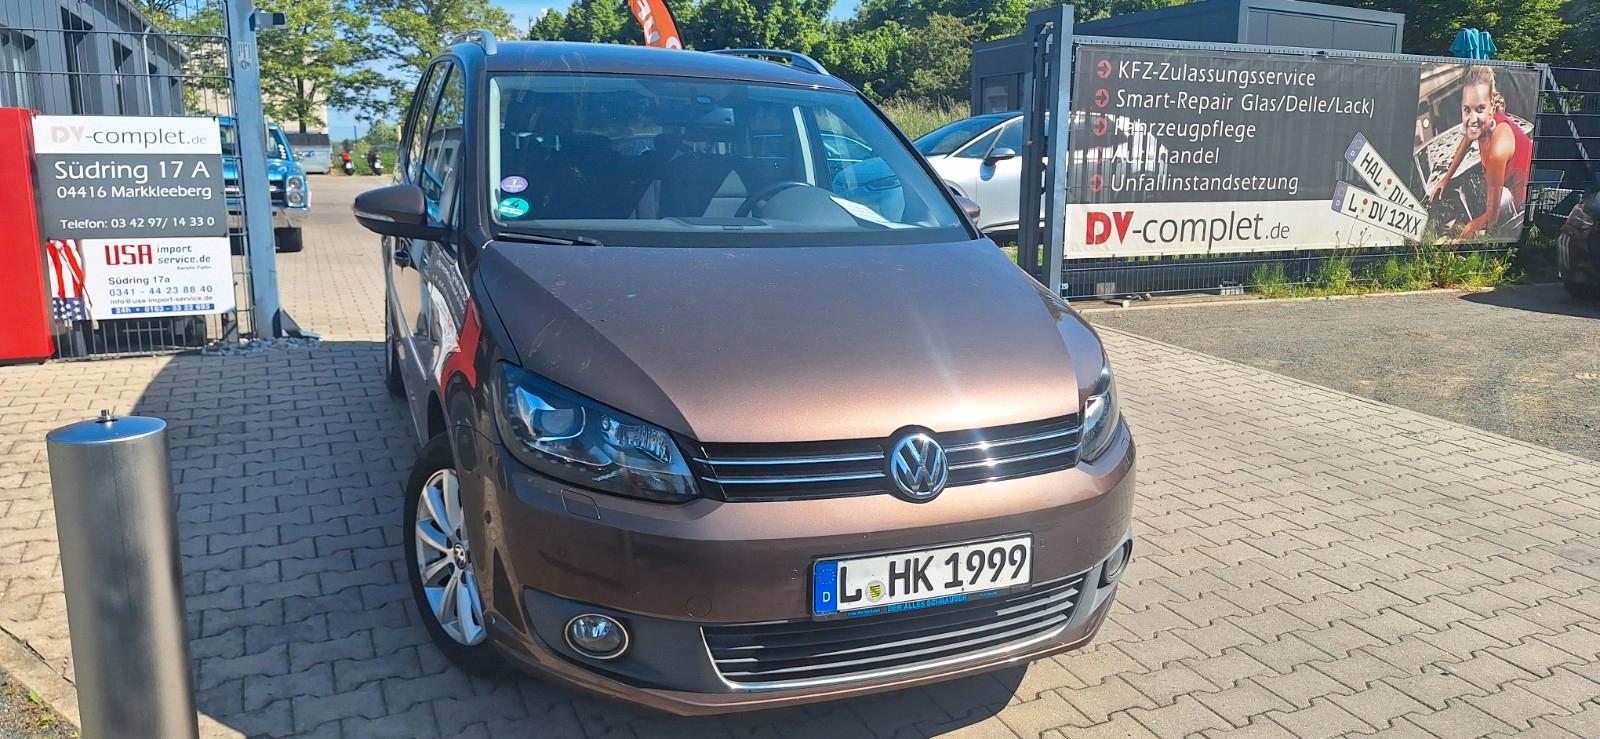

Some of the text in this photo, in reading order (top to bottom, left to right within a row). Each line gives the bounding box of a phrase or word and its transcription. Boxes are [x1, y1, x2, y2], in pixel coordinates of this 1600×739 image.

[1117, 60, 1316, 89] KFZ-Zulassungsservice
[1116, 89, 1375, 119] Smart-Repair Glas/Delle/Lack)
[50, 125, 208, 149] DV-complet.de
[1114, 119, 1257, 143] Fahrzeugpflege
[1111, 147, 1220, 164] Authandel
[54, 160, 211, 184] Südring 17 A
[1360, 152, 1383, 187] HAL
[56, 185, 212, 200] 04416 Markkleeberg
[1110, 172, 1299, 194] Unfallinstandsetzung
[59, 216, 215, 229] Telefon: 03 42 97/ 14 33 0
[1348, 193, 1358, 212] L
[1368, 201, 1388, 222] DV
[1387, 209, 1421, 236] 12XX
[1086, 210, 1291, 250] DV-complet.de
[104, 244, 192, 266] USA import
[158, 254, 211, 264] service.de
[108, 275, 170, 286] Südring 17a
[109, 288, 135, 297] 0341
[149, 287, 161, 295] 44
[166, 286, 179, 294] 23
[183, 285, 196, 294] 88
[200, 285, 213, 293] 40
[839, 544, 1027, 604] L HK 1999
[822, 591, 831, 602] D
